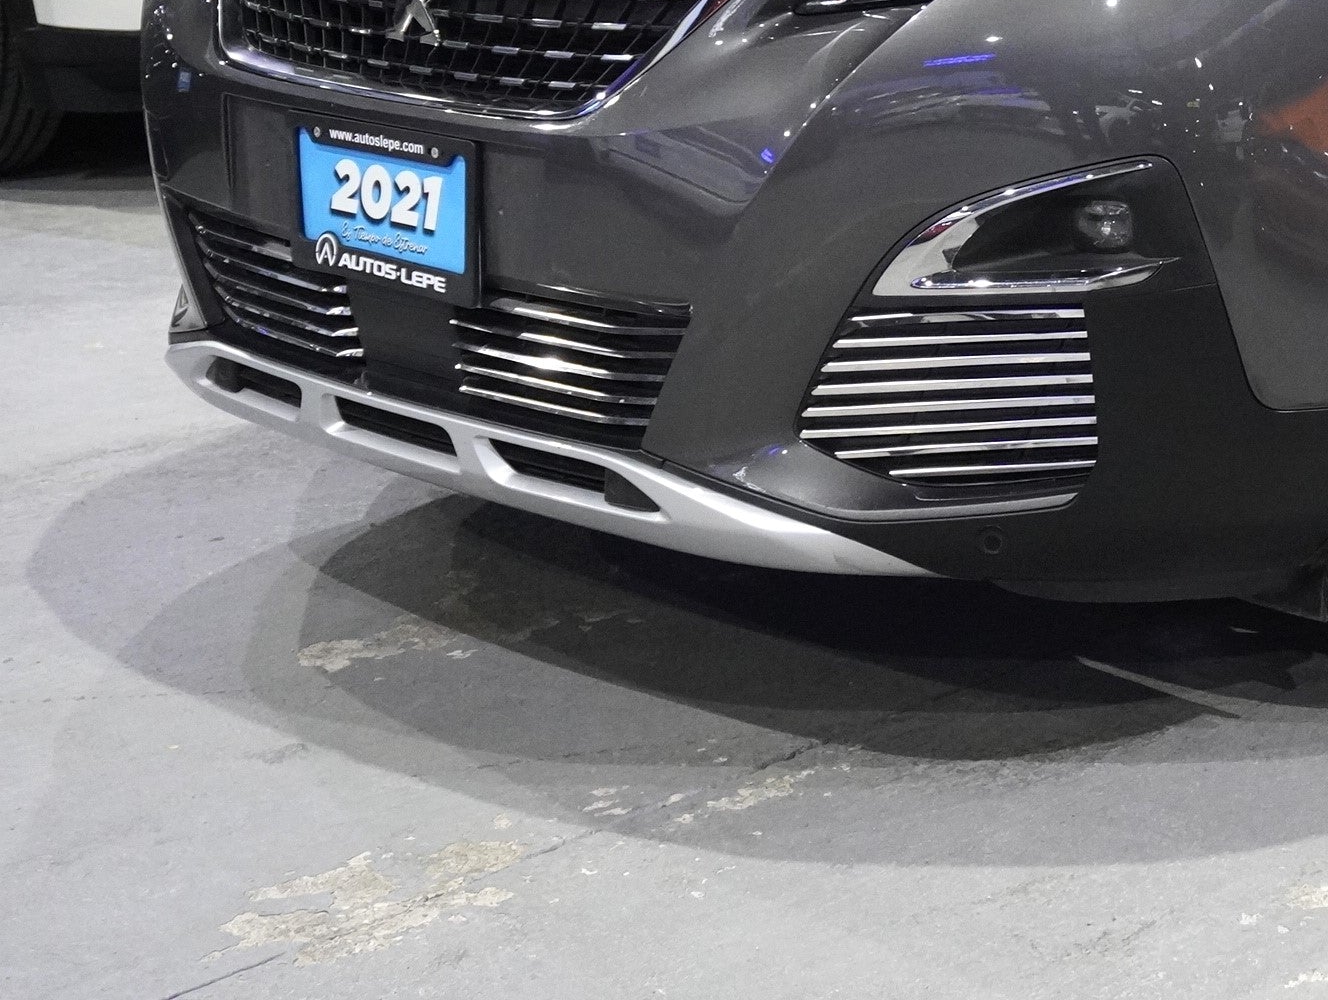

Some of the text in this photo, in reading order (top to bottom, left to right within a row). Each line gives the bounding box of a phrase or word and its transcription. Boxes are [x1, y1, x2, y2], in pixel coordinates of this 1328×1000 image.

[329, 127, 425, 155] www.autoslepe.com
[331, 158, 443, 231] 2021
[381, 235, 392, 247] de
